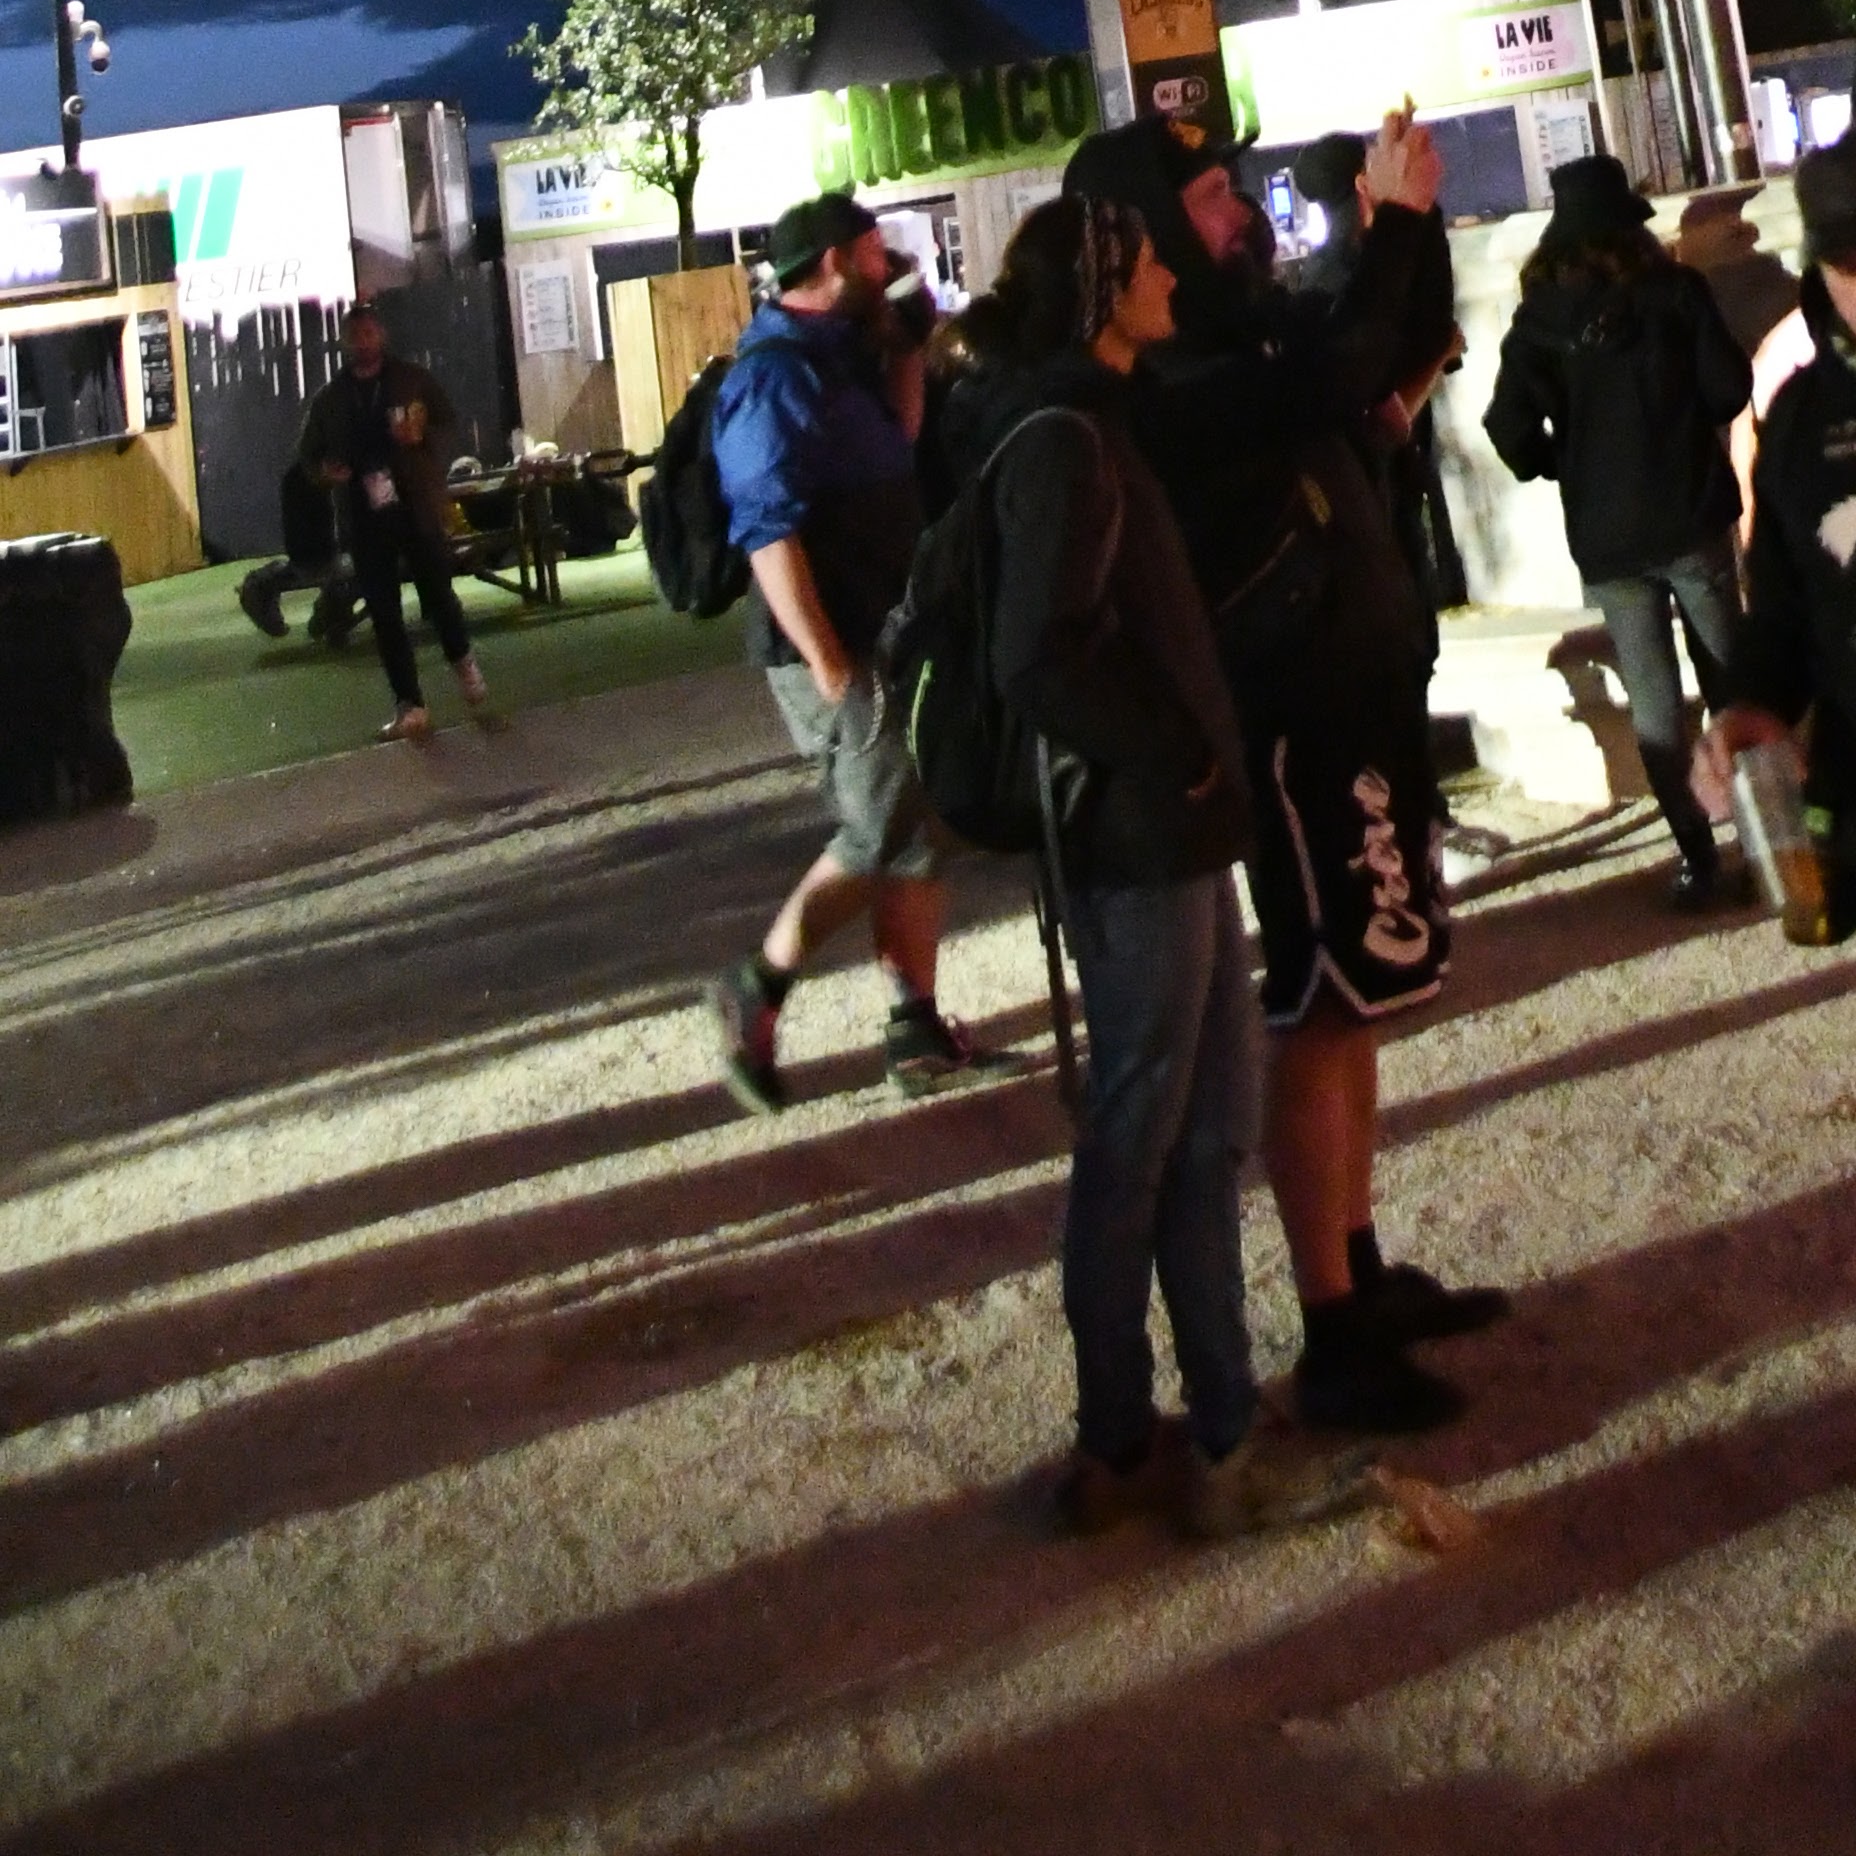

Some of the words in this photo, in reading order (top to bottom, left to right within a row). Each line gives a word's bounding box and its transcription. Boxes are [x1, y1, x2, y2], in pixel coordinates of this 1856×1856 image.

[1495, 22, 1519, 49] LA
[1520, 15, 1553, 45] VIE
[1500, 58, 1557, 77] INSIDE
[536, 168, 557, 194] LA
[539, 205, 589, 219] INSIDE
[185, 257, 302, 303] ESTIER
